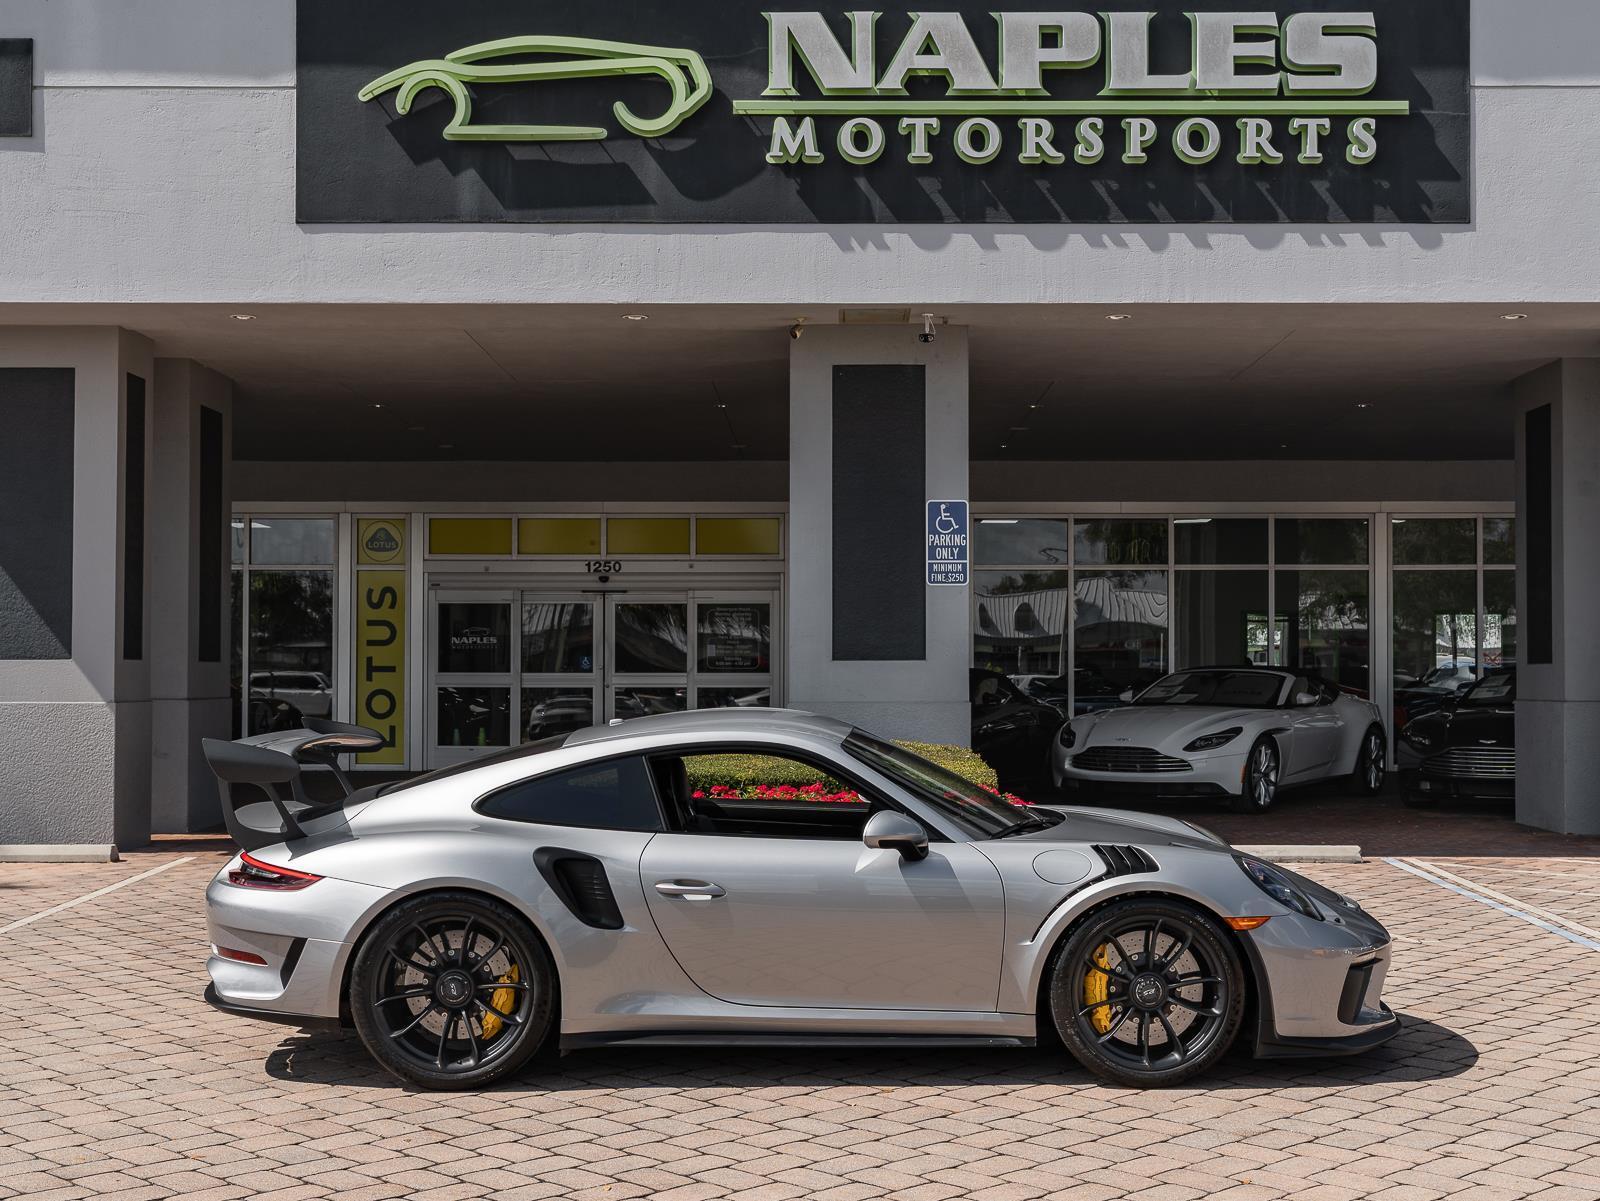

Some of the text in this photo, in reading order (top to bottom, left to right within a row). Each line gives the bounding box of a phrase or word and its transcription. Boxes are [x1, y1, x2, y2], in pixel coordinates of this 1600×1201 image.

[762, 11, 1378, 96] NAPLES
[764, 117, 1378, 165] MOTORSPORTS
[368, 541, 397, 549] LOTUS
[929, 535, 966, 546] PARKING
[936, 548, 959, 559] ONLY
[585, 561, 622, 573] 1250
[933, 563, 962, 572] MINIMUM
[931, 573, 964, 582] FINE $250
[451, 636, 497, 644] NAPLES
